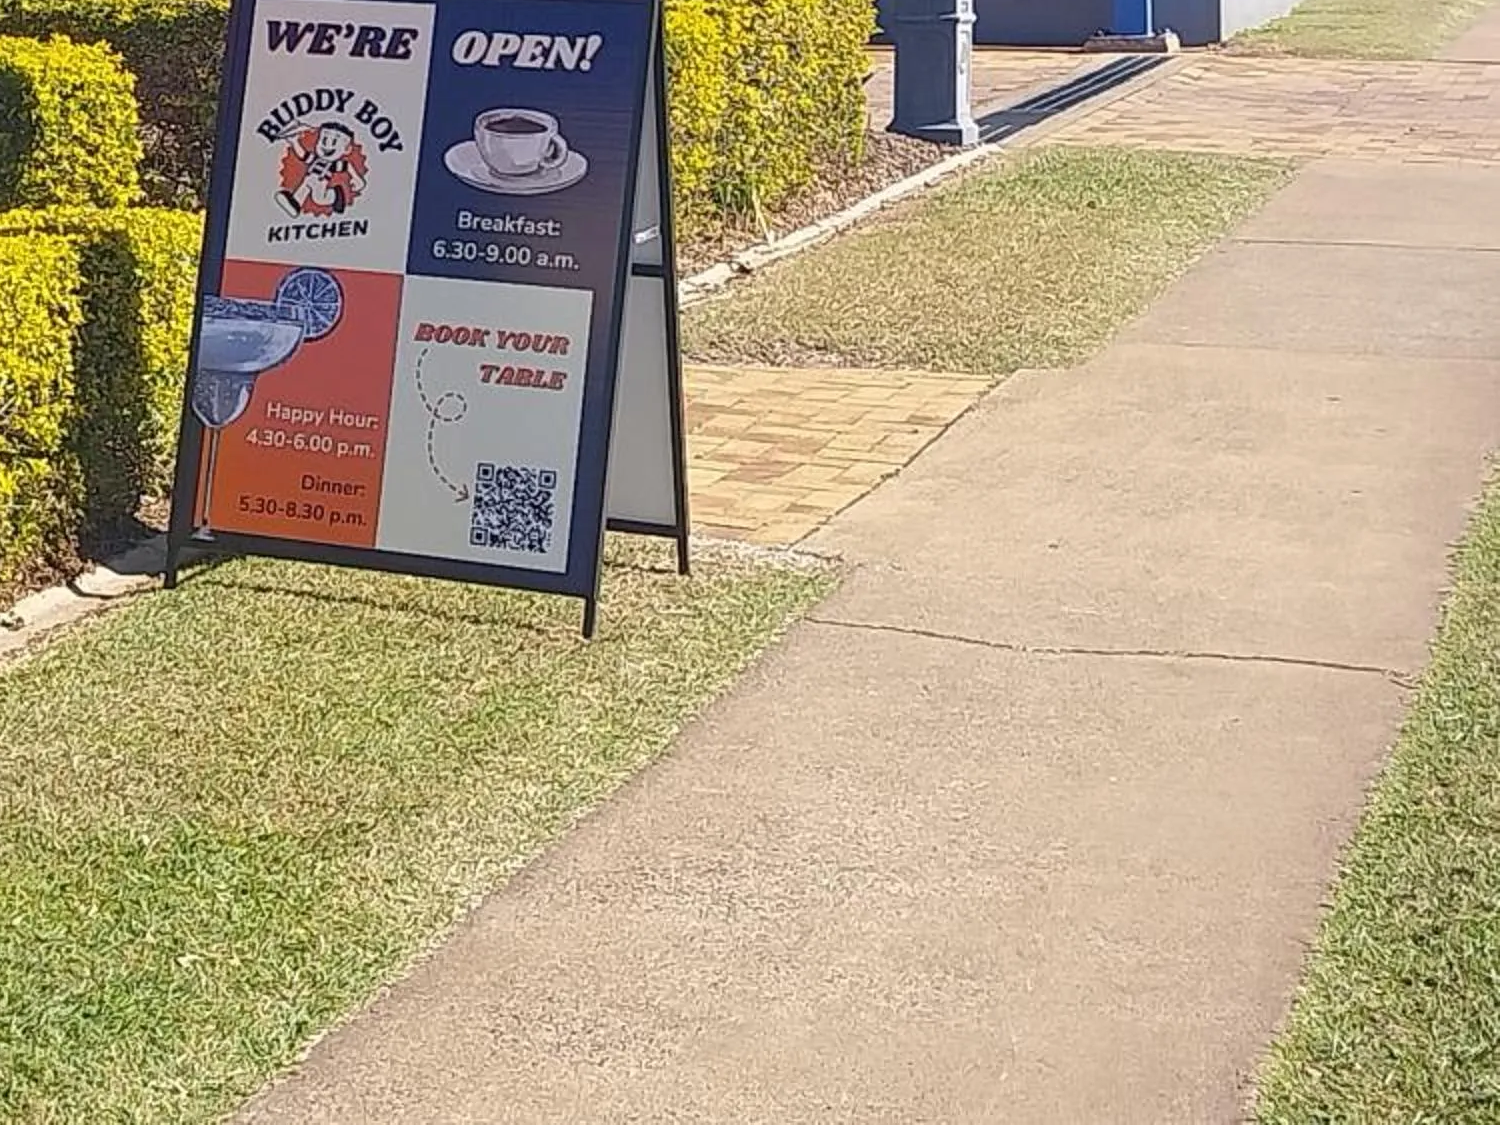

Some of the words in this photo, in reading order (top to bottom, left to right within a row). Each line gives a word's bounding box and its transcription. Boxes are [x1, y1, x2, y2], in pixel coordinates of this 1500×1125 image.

[265, 20, 419, 61] WE'RE
[451, 30, 603, 72] OPEN!
[256, 88, 355, 143] BUDDY
[354, 99, 404, 152] BOY
[267, 219, 369, 242] KITCHEN
[457, 211, 562, 237] Breakfast:
[432, 240, 531, 267] 6.30-9.00
[535, 251, 581, 271] a.m.
[414, 322, 492, 349] BOOK
[494, 330, 570, 356] YOUR
[479, 363, 568, 391] TABLE
[266, 402, 324, 428] Happy
[329, 409, 379, 430] Hour:
[245, 429, 333, 453] 4.30-6.00
[336, 439, 377, 460] p.m.
[301, 474, 366, 497] Dinner:
[238, 495, 325, 521] 5.30-8.30
[329, 508, 368, 528] p.m.
